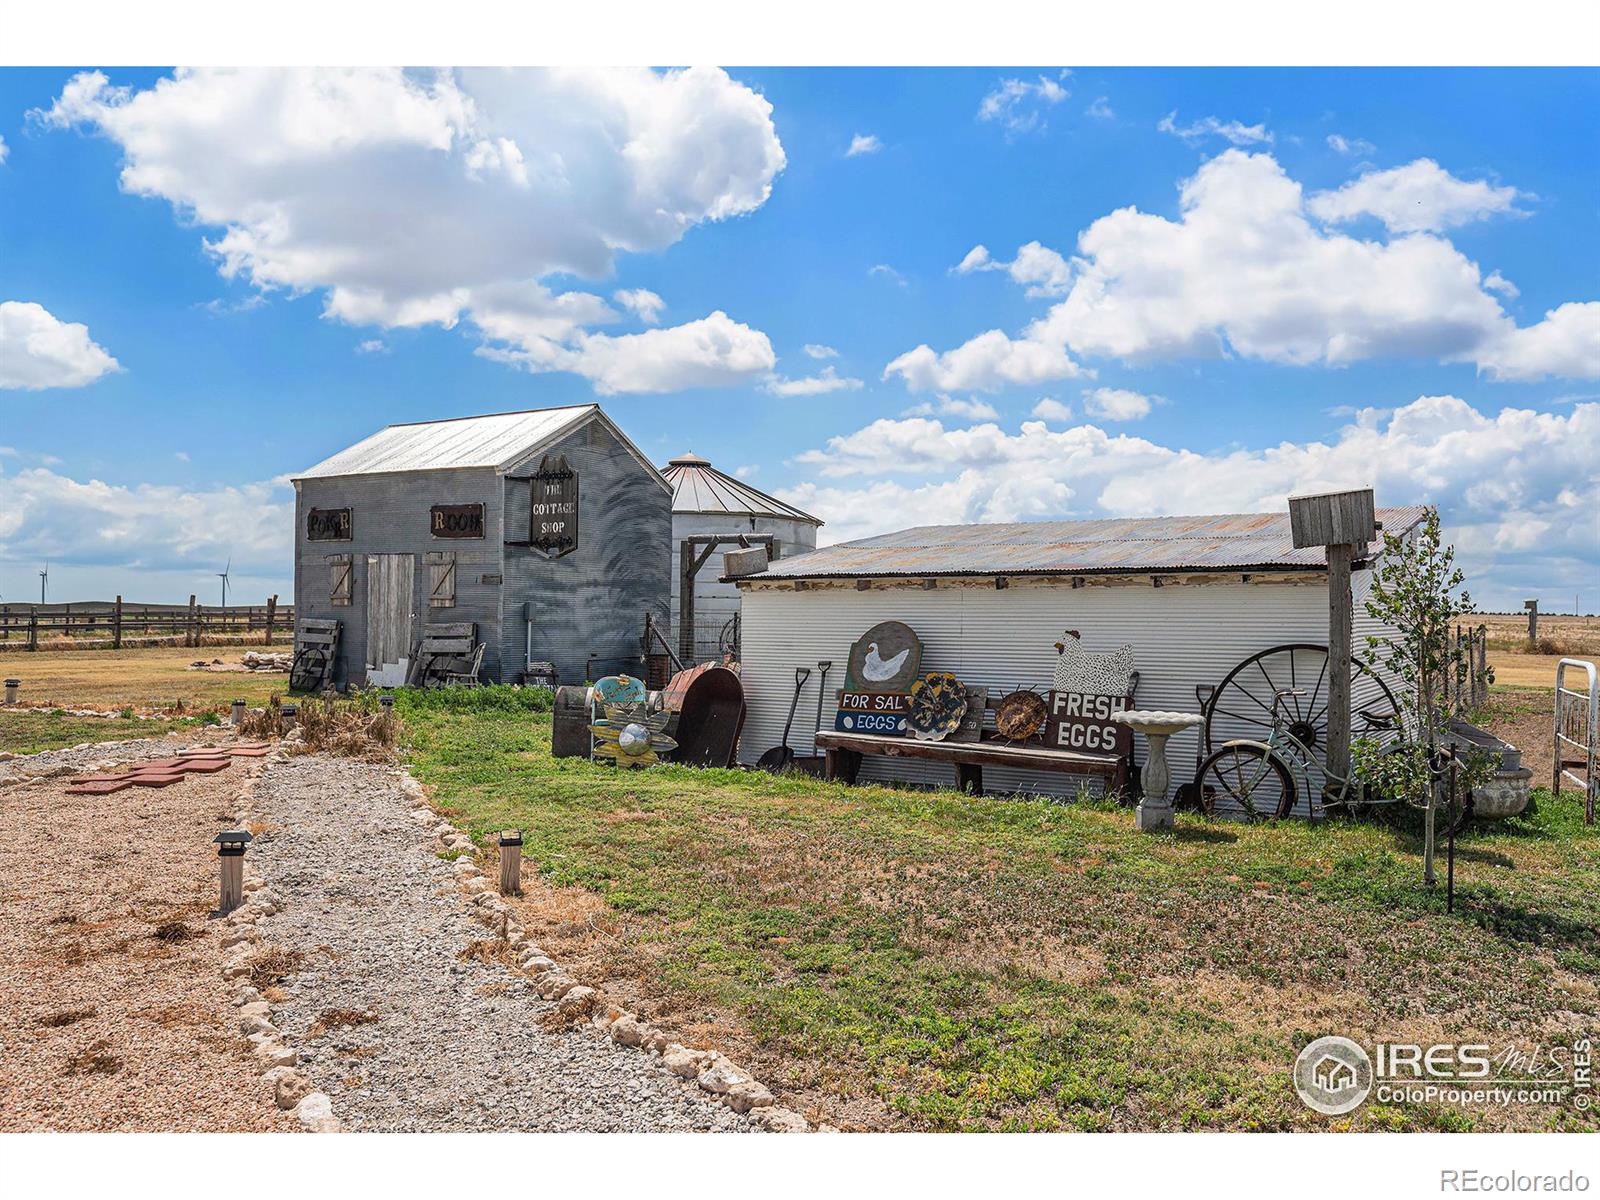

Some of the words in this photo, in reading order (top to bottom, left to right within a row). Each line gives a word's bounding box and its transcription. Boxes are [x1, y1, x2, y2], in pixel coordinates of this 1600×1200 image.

[541, 521, 565, 534] SHOP
[842, 694, 870, 709] FOR
[875, 695, 912, 710] SAL
[1053, 692, 1126, 721] FRESH
[857, 715, 896, 730] EGGS
[1057, 721, 1117, 750] EGGS
